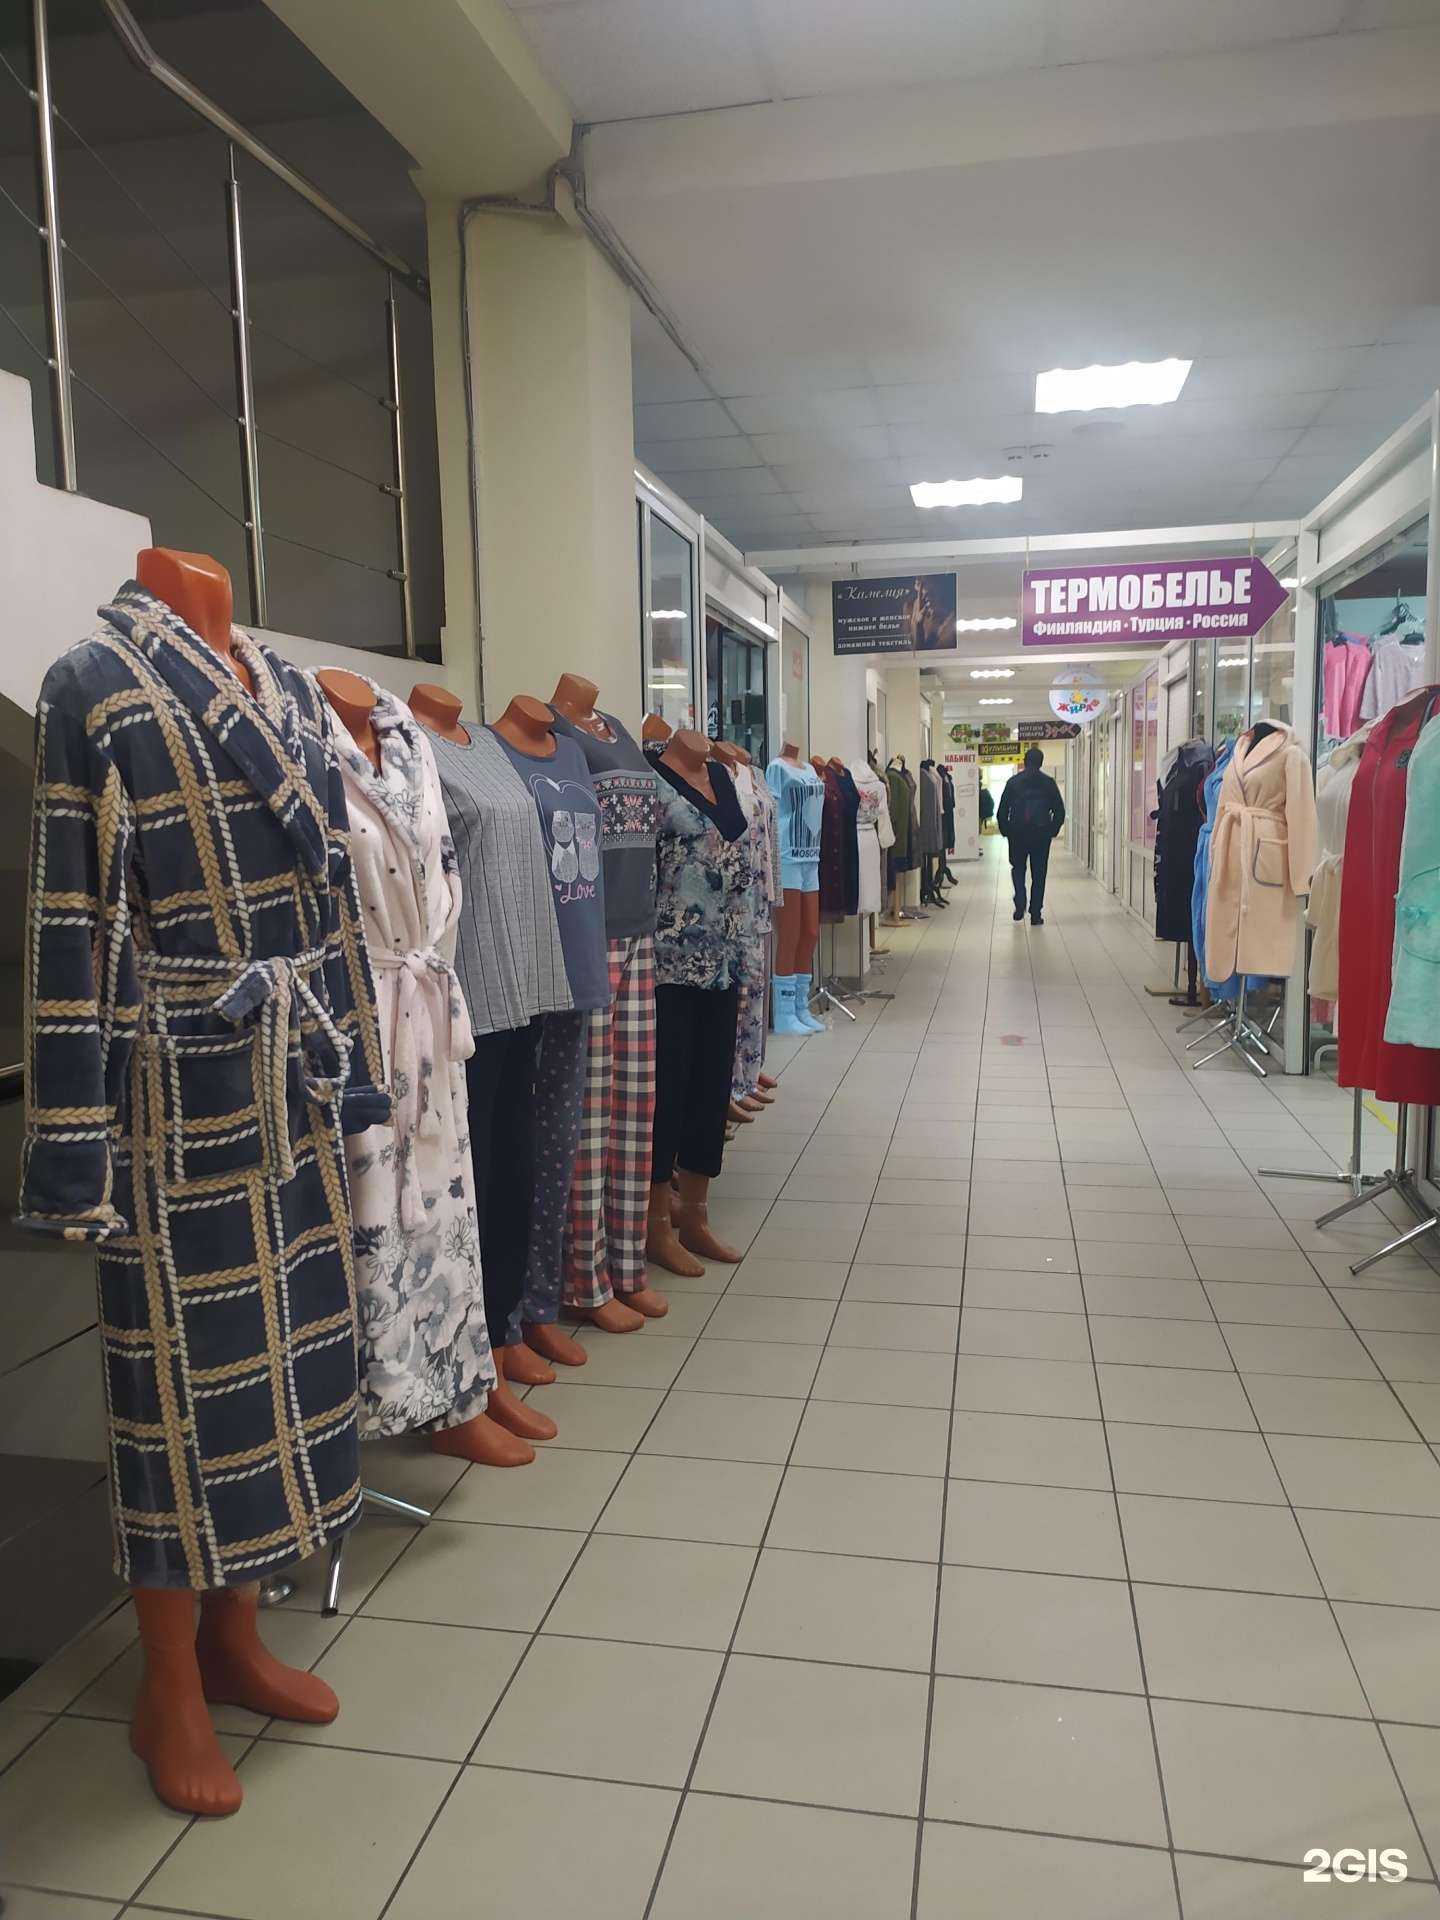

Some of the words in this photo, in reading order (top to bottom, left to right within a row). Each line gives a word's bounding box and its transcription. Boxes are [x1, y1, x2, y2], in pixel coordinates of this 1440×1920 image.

[1031, 568, 1252, 614] ТЕРМОБЕЛЬЕ
[1033, 617, 1121, 637] Финляндия
[1130, 614, 1184, 634] Турция
[1192, 612, 1249, 629] Россия
[560, 883, 596, 904] Love
